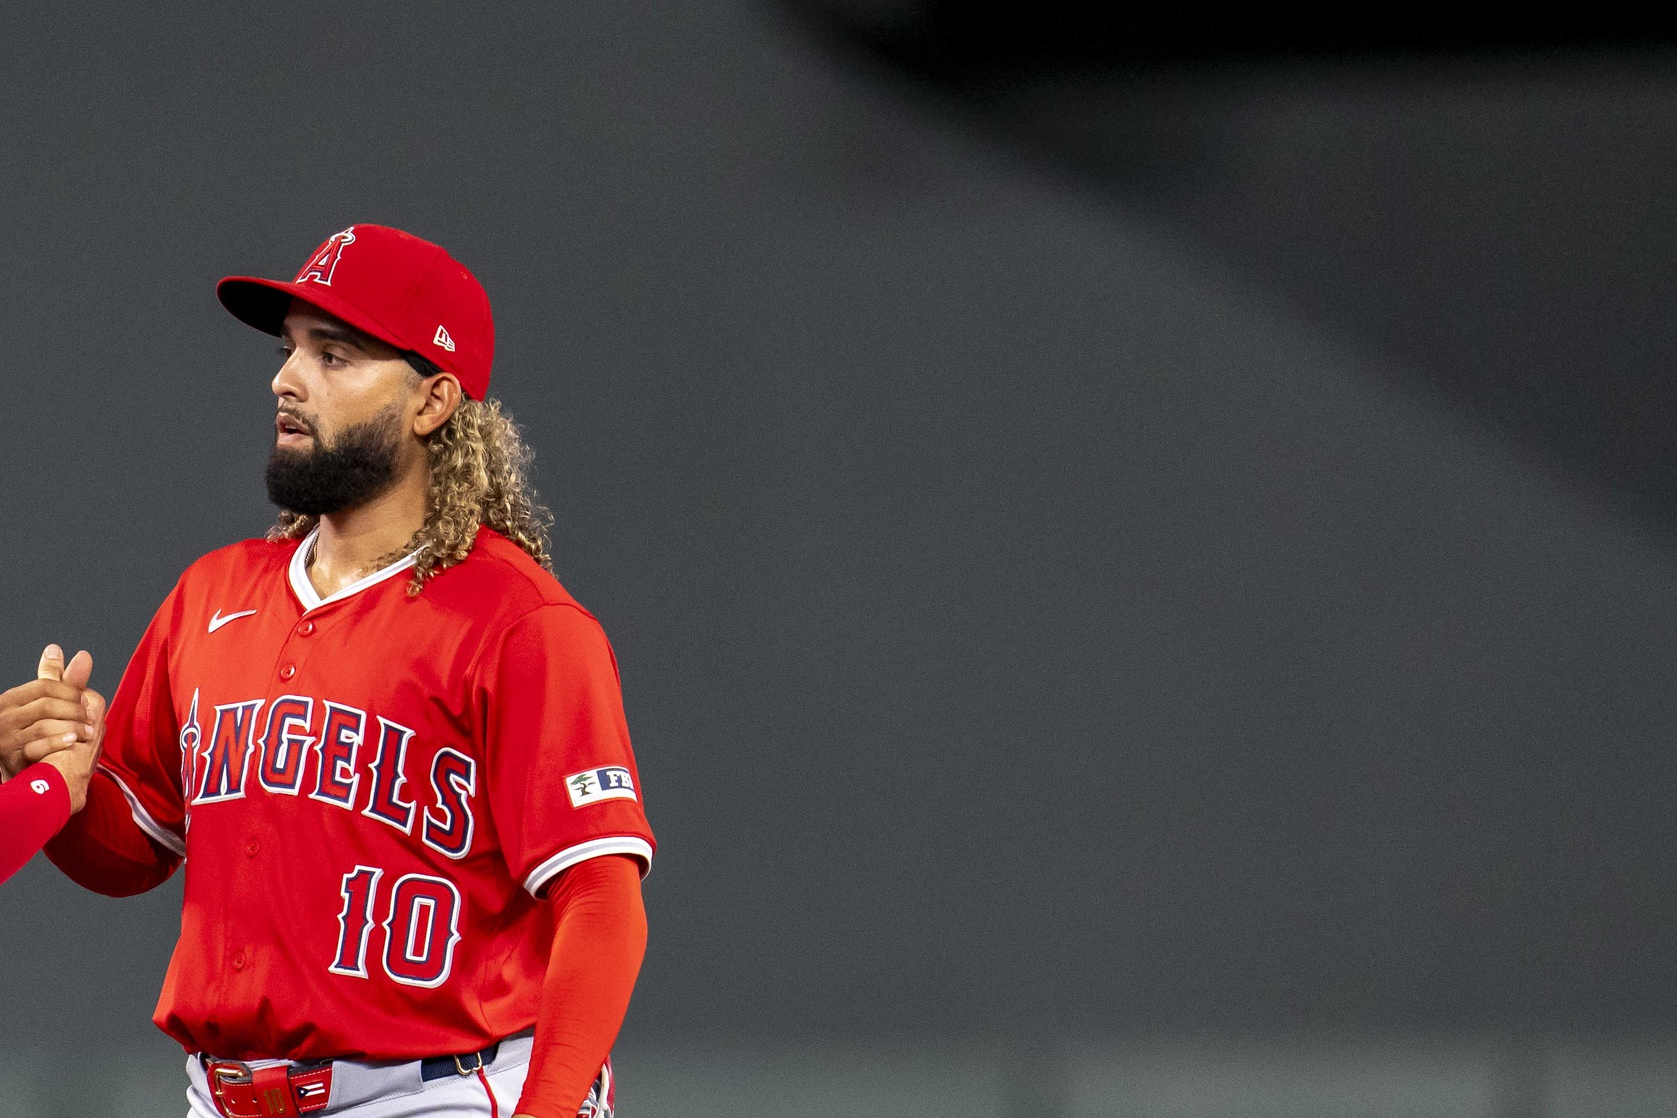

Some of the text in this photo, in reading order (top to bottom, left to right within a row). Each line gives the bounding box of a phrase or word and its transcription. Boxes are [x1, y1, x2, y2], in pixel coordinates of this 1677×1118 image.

[179, 686, 477, 860] ANGELS
[606, 770, 635, 789] FB
[328, 864, 462, 989] 10
[263, 1087, 286, 1115] 10
